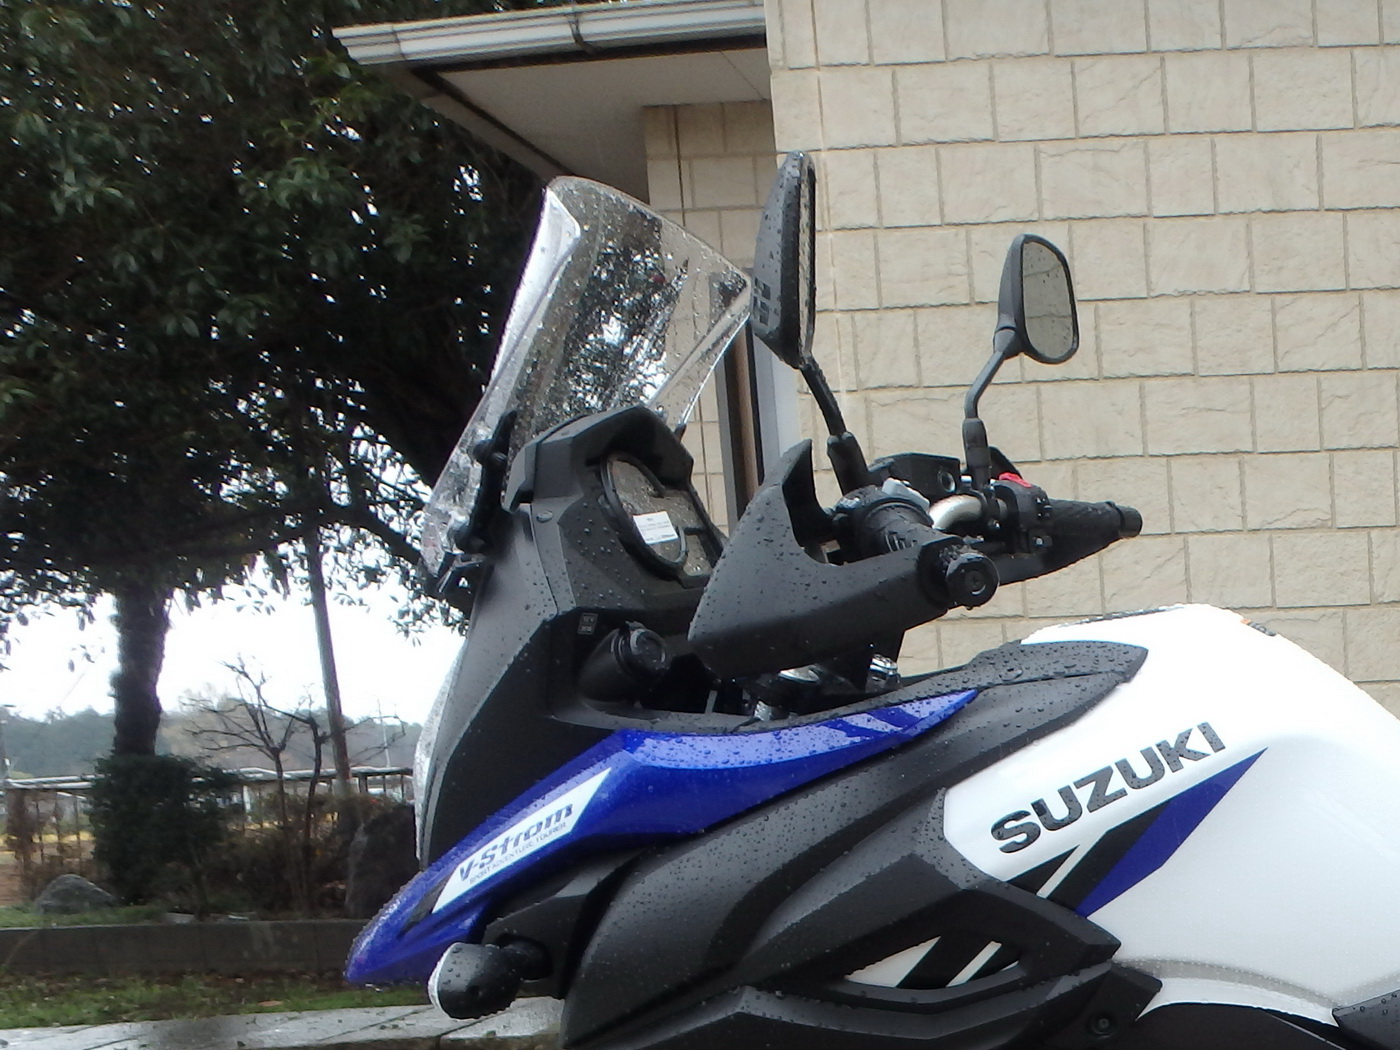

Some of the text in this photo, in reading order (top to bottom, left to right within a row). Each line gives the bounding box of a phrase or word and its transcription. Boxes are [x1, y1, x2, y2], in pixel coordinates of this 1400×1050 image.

[990, 721, 1226, 853] SUZUKI
[459, 803, 574, 882] V-Strom
[536, 821, 567, 842] TOURER
